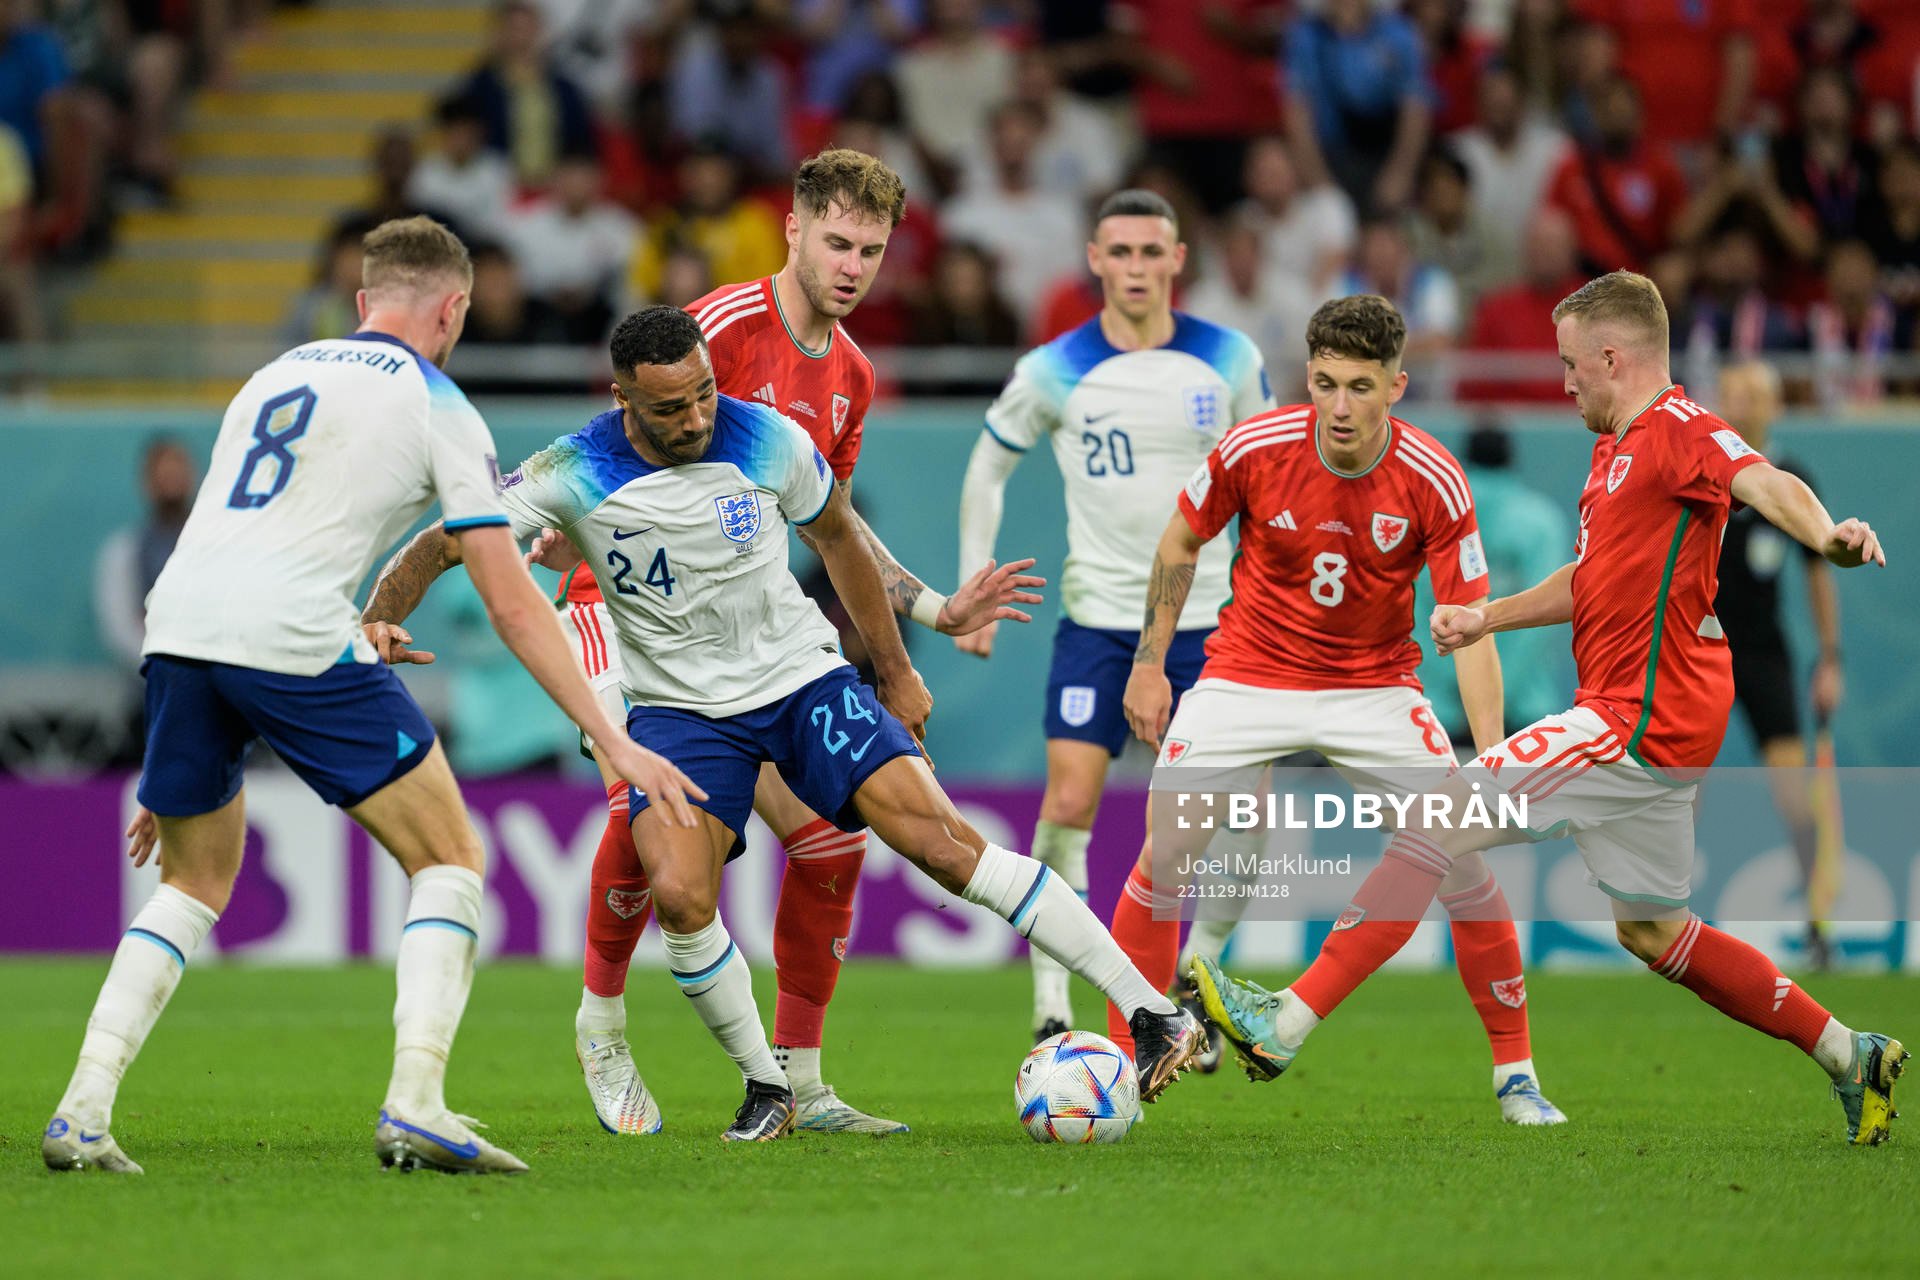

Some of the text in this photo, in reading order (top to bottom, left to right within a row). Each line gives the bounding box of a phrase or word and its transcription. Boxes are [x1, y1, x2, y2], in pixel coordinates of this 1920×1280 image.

[226, 384, 319, 510] 8
[1082, 428, 1134, 477] 20
[607, 547, 676, 597] 24
[1310, 552, 1348, 608] 8
[811, 686, 877, 755] 24
[1410, 706, 1449, 756] 8
[1507, 726, 1567, 763] 6
